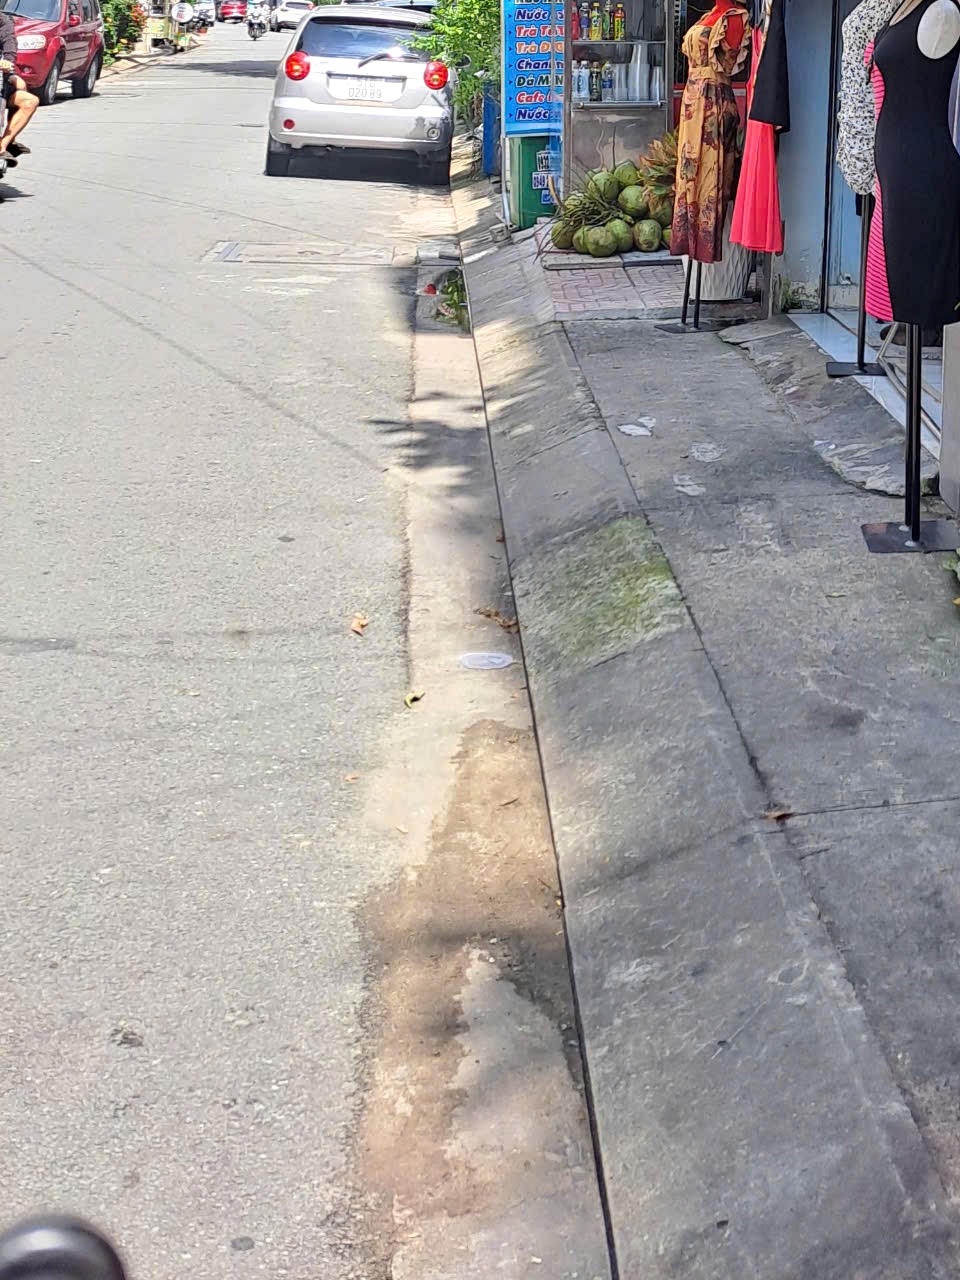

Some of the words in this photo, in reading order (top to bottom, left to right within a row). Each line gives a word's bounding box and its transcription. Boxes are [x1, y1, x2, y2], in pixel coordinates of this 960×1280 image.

[516, 8, 548, 20] Nước
[516, 25, 537, 36] Trà
[517, 41, 537, 53] Trà
[517, 75, 535, 86] Đá
[517, 107, 549, 120] Nước
